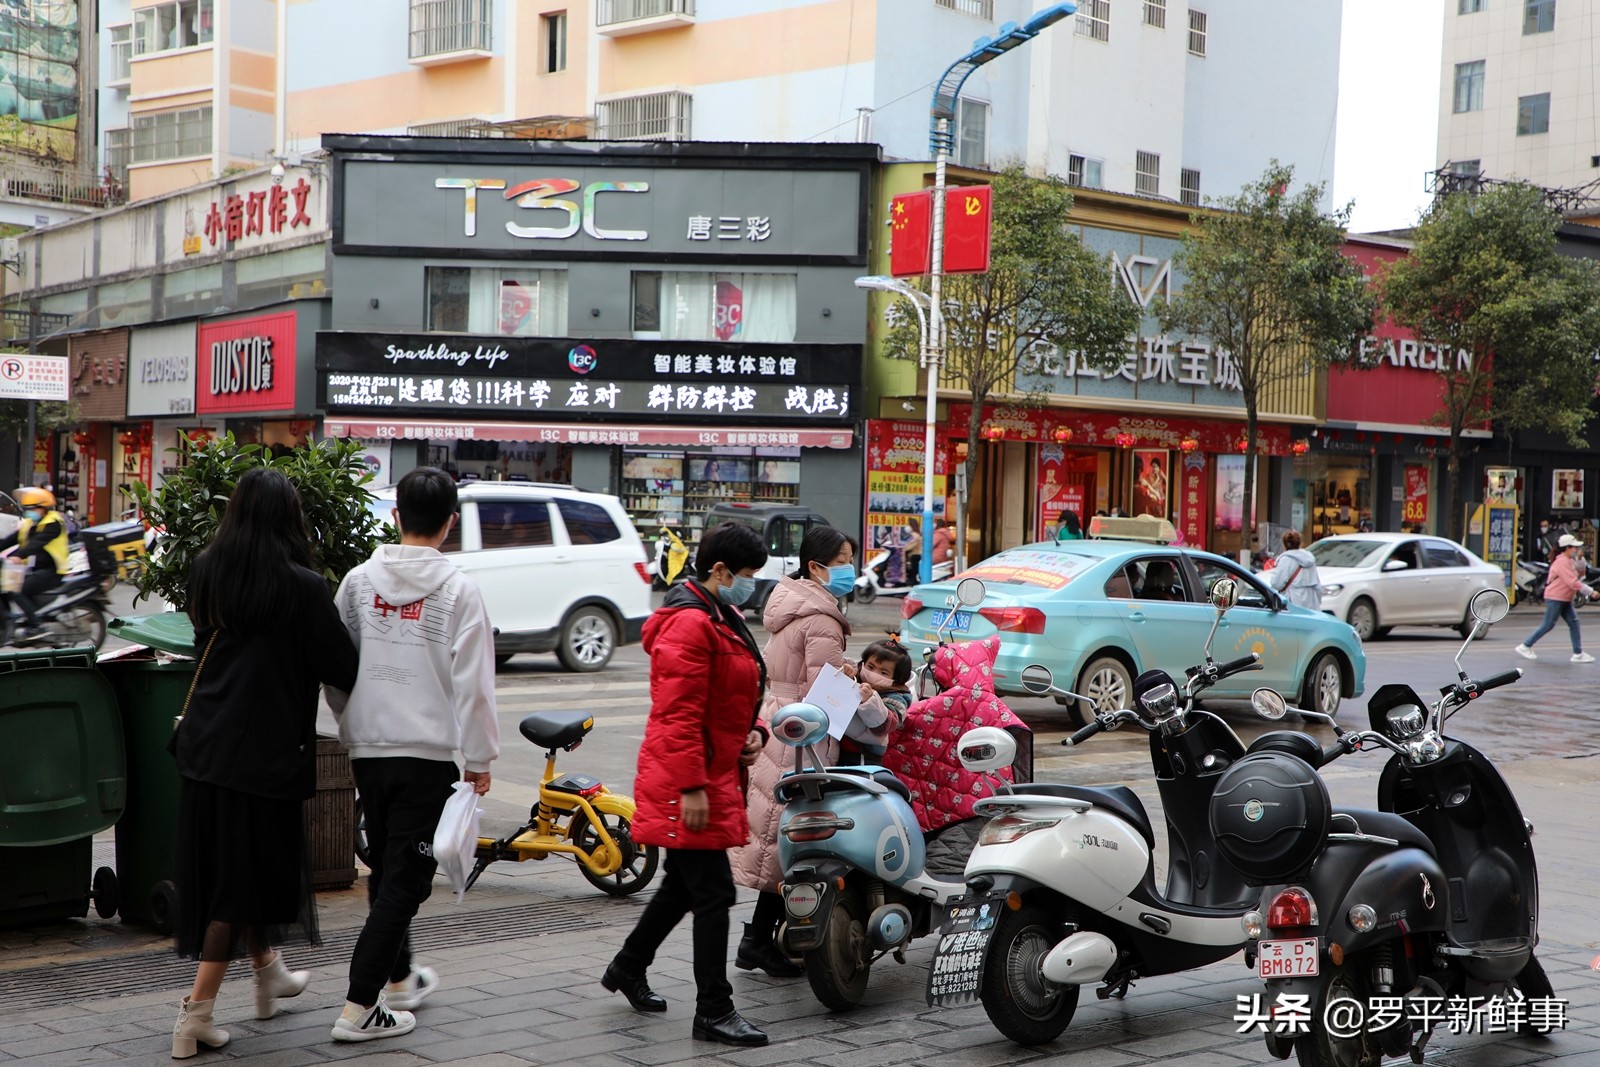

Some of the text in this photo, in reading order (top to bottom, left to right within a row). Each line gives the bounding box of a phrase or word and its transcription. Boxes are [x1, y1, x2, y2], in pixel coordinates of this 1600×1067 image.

[203, 178, 312, 247] 小桔灯作文
[435, 178, 649, 240] T3C
[687, 215, 772, 241] 唐三彩
[210, 336, 262, 396] DUSTO
[261, 337, 274, 391] 大東
[384, 343, 510, 369] Sparkling Life
[654, 354, 797, 376] 智能美妆体验馆
[565, 381, 621, 409] 应对
[647, 384, 757, 413] 群防群控
[404, 426, 474, 438] 智能美妆体验馆
[568, 429, 640, 442] 智能美妆体验馆
[727, 432, 799, 444] 智能美妆体验馆
[1187, 475, 1200, 536] 新春快乐
[1272, 944, 1304, 957] 云 D
[1261, 957, 1316, 975] BM872
